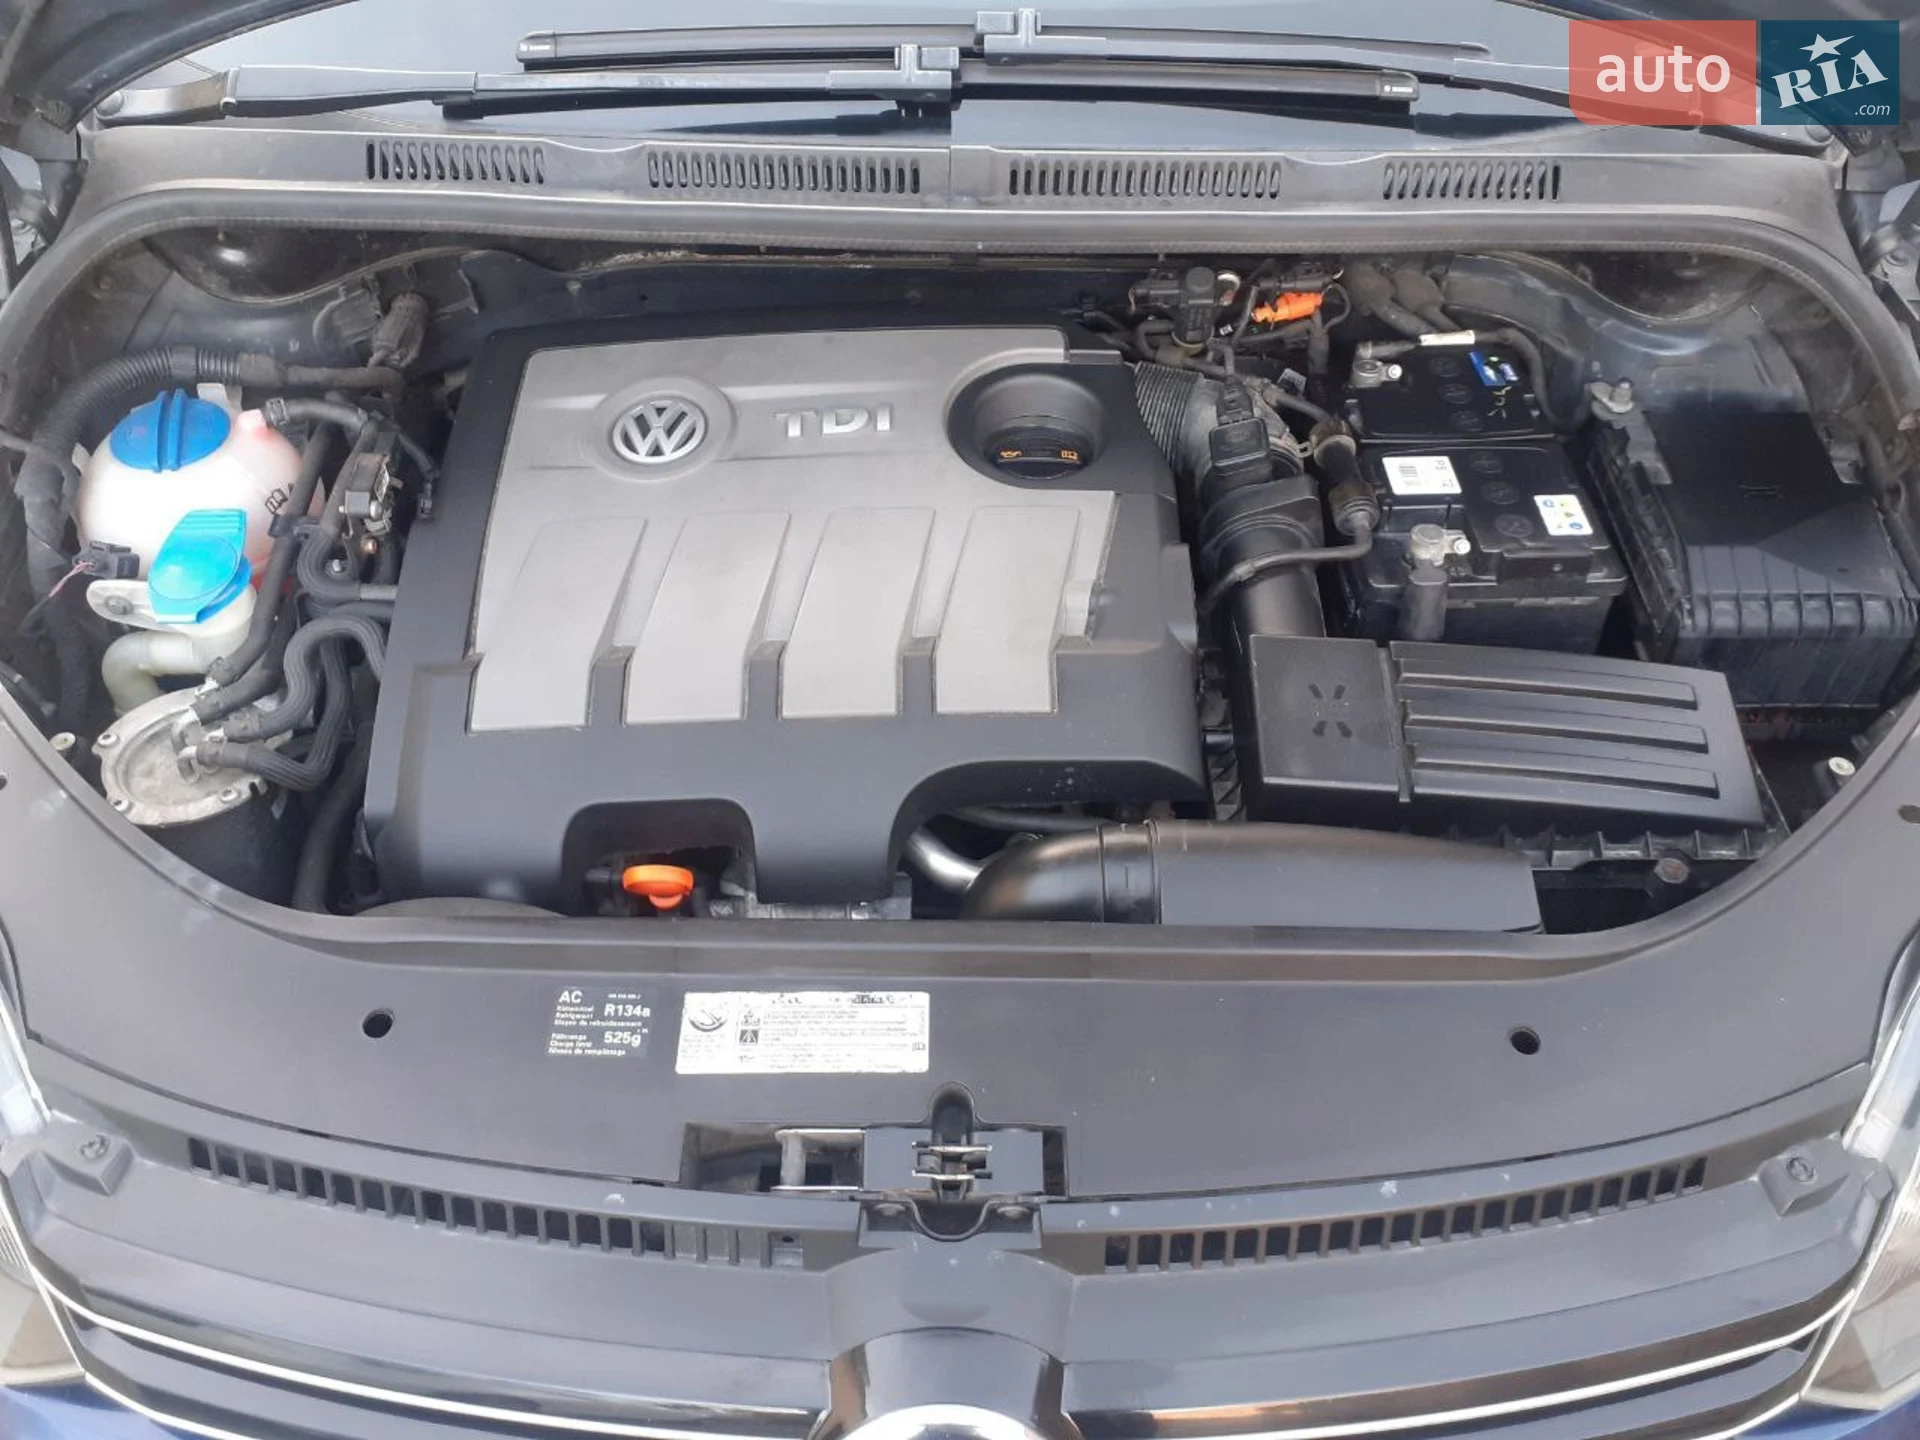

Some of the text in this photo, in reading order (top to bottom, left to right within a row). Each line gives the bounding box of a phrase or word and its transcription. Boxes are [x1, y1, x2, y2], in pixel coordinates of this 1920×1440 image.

[774, 404, 892, 438] TDI
[559, 990, 582, 1003] AC
[604, 1003, 650, 1017] R134a
[604, 1031, 641, 1048] 525g
